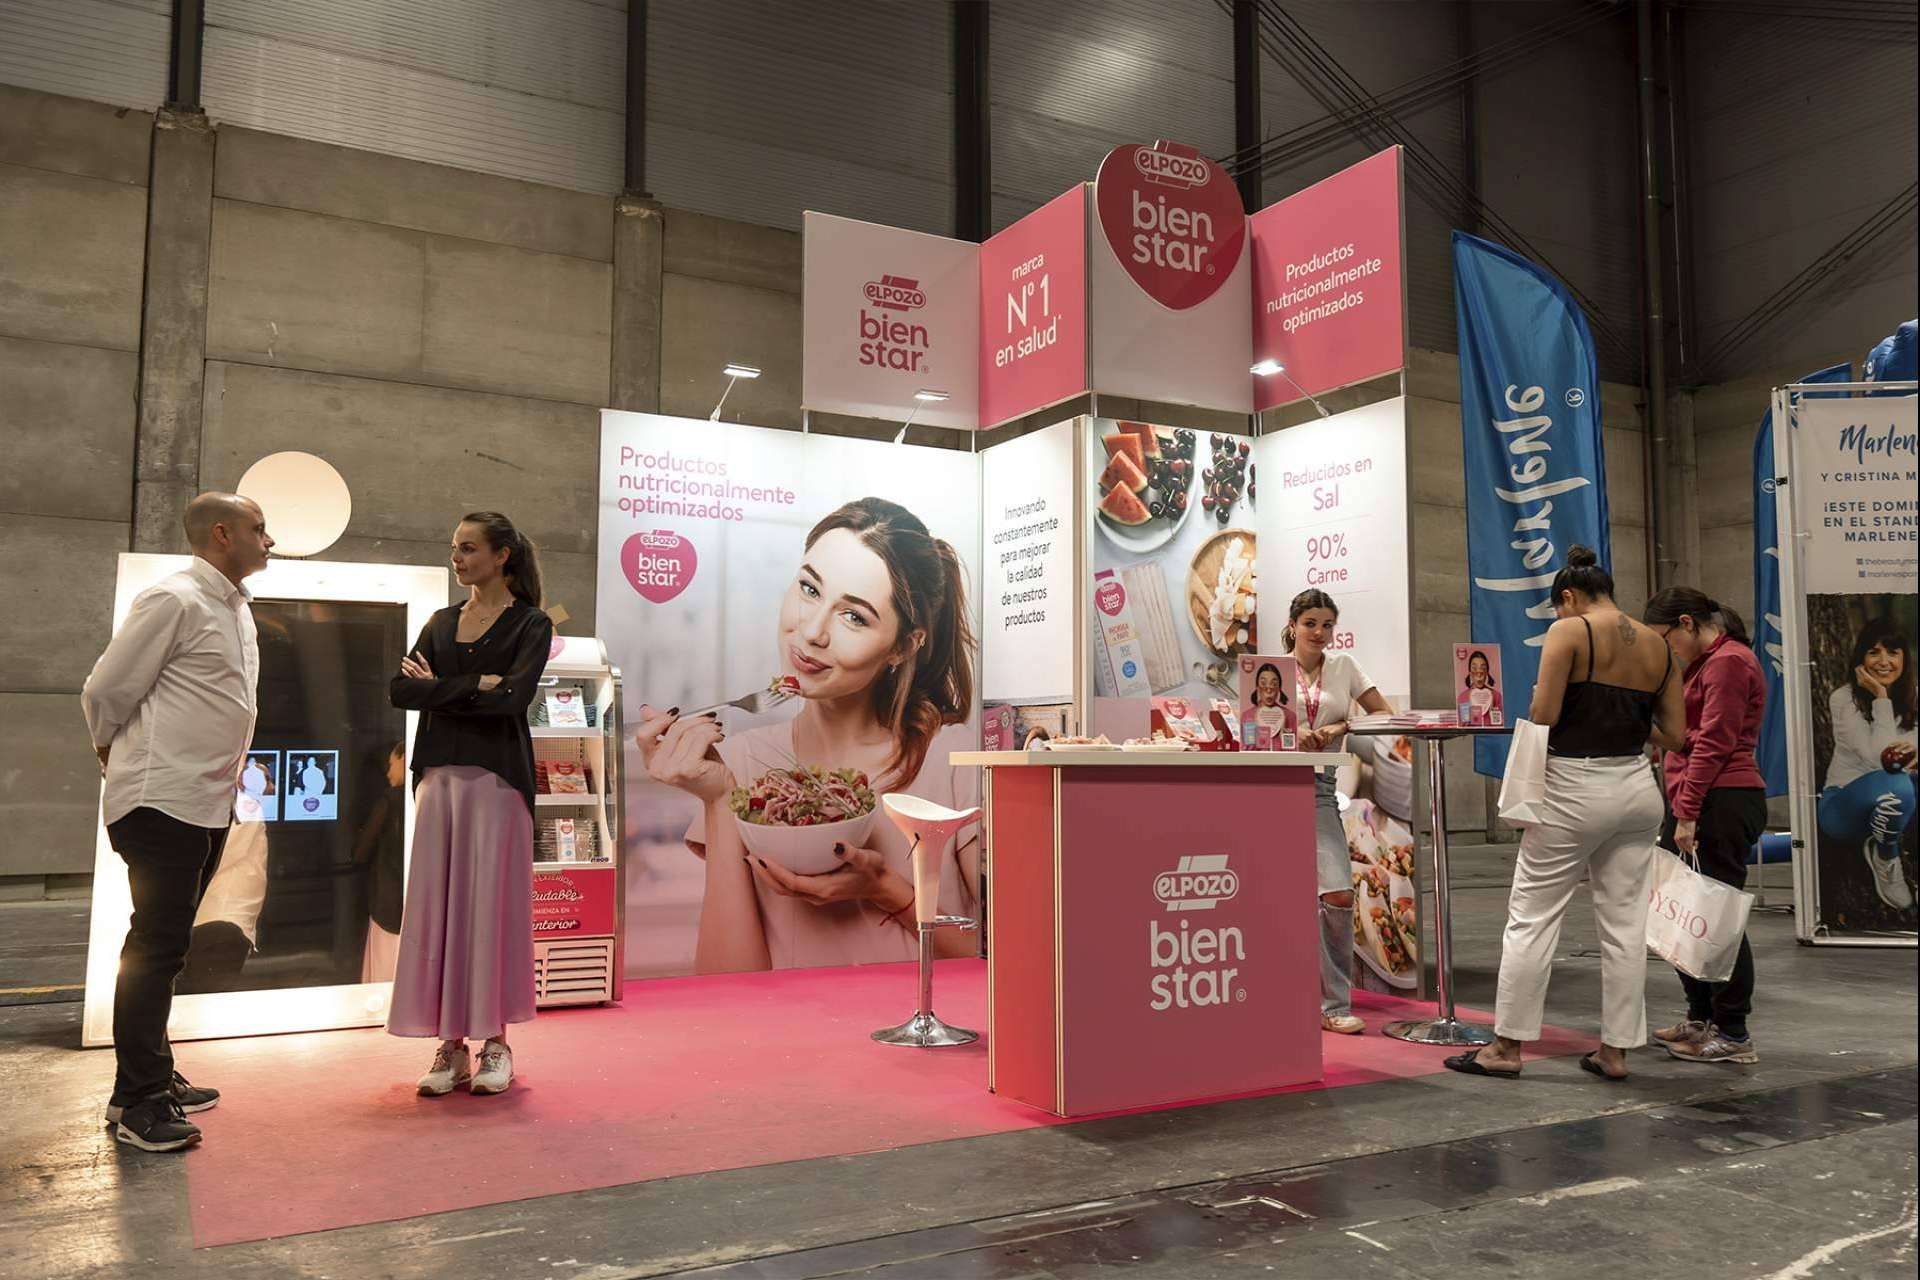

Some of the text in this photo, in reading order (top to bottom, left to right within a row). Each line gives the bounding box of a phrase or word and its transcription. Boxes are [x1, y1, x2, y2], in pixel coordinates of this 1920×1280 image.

[1132, 190, 1215, 242] bien
[1012, 253, 1044, 281] marca
[1286, 243, 1355, 282] Productos
[1040, 273, 1049, 317] 1
[1266, 258, 1382, 314] nutricionalmente
[1283, 291, 1364, 334] optimizados
[860, 309, 929, 348] bien
[995, 344, 1014, 368] en
[1839, 423, 1918, 465] Marlen
[620, 446, 728, 476] Productos
[1283, 457, 1373, 490] Reducidos en
[619, 473, 796, 505] nutricionalmente
[1821, 473, 1829, 483] Y
[1835, 471, 1900, 482] CRISTINA
[618, 495, 744, 521] optimizados
[1005, 497, 1046, 521] Innovando
[1313, 484, 1339, 511] Sal
[1873, 501, 1918, 512] DOMI
[993, 517, 1059, 545] constantemente
[1824, 516, 1843, 528] EN
[1850, 516, 1867, 527] EL
[1307, 532, 1348, 562] 90%
[1844, 531, 1917, 542] MARLENE
[638, 552, 682, 572] bien
[1000, 541, 1052, 568] para mejorar
[1006, 562, 1043, 584] la calidad
[1307, 567, 1348, 586] Carne
[1001, 586, 1048, 606] de nuestros
[1005, 609, 1046, 632] productos
[1326, 631, 1355, 651] asa
[1150, 919, 1246, 968] bien
